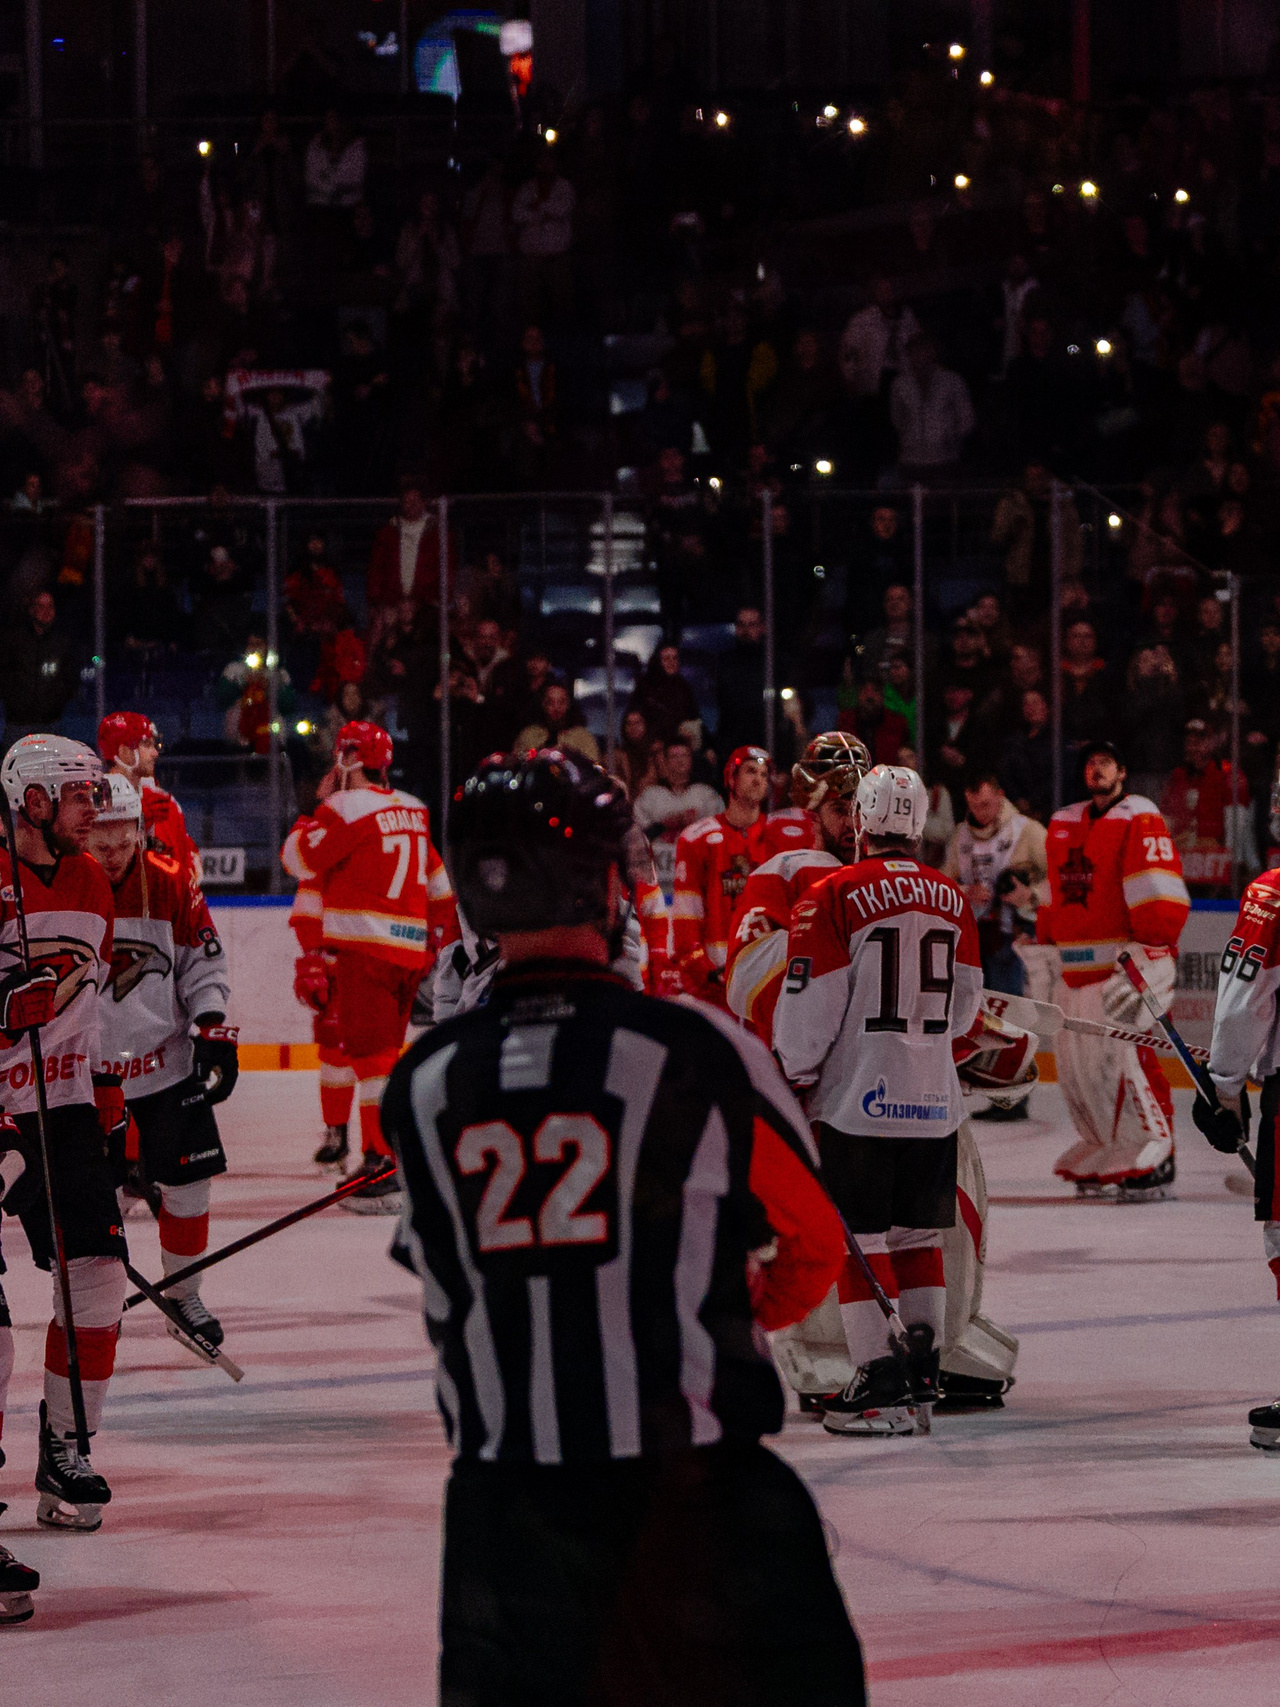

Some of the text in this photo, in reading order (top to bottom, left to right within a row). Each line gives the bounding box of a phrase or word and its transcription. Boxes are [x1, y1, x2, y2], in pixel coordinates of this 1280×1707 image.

[894, 797, 912, 815] 19
[382, 833, 429, 900] 71
[1142, 836, 1174, 862] 29
[847, 876, 963, 919] TKACHYOV
[735, 906, 771, 942] 45
[786, 956, 813, 994] 9
[865, 927, 954, 1034] 19
[1220, 936, 1268, 982] 66
[455, 1112, 611, 1253] 22
